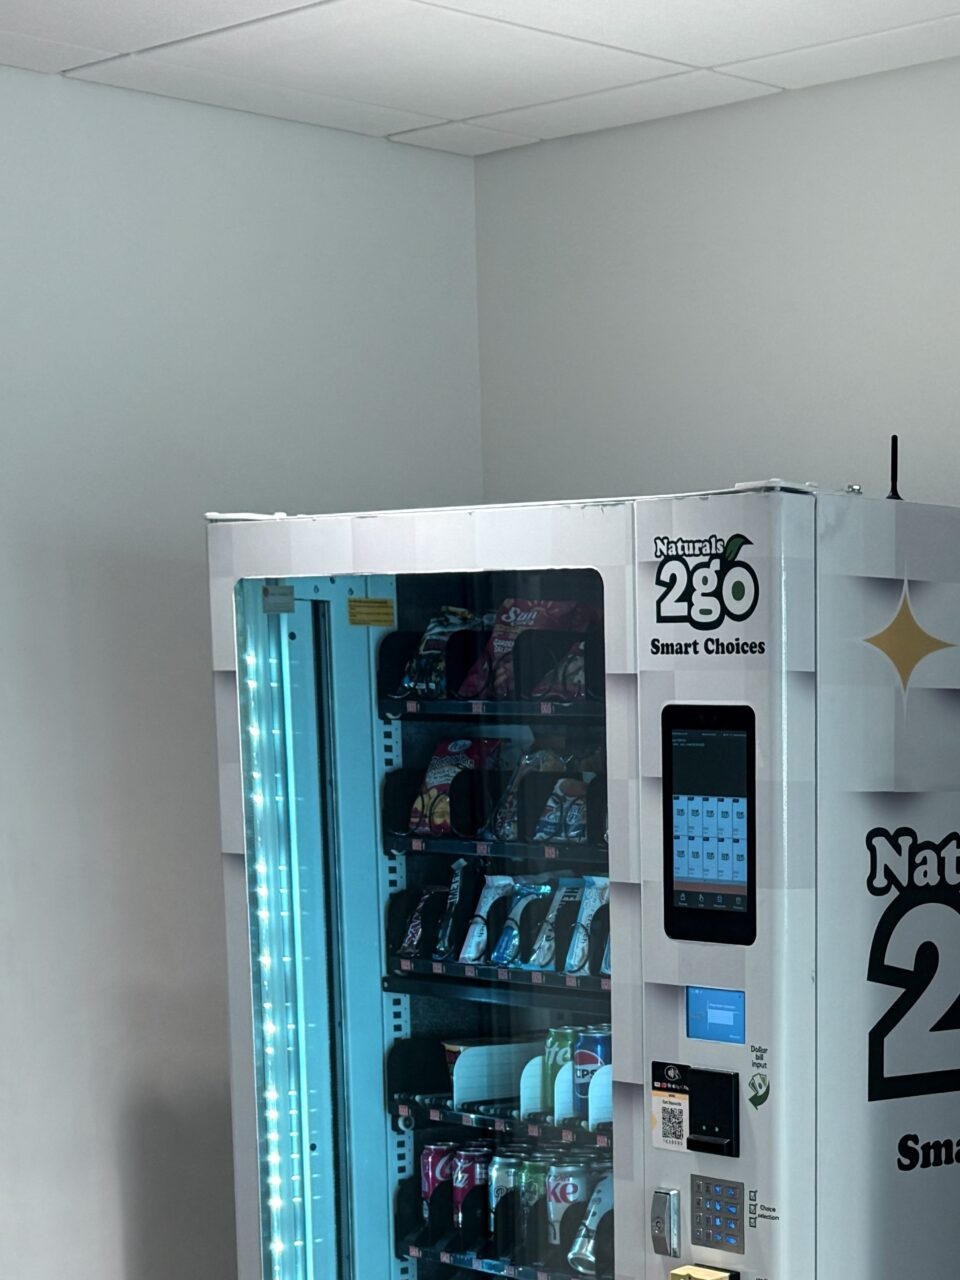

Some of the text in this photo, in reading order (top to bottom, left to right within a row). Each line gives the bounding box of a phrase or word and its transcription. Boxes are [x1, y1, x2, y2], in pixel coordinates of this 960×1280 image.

[654, 535, 725, 558] Naturals
[656, 556, 759, 631] 2go
[650, 637, 766, 655] Smart Choices
[752, 1061, 767, 1069] input
